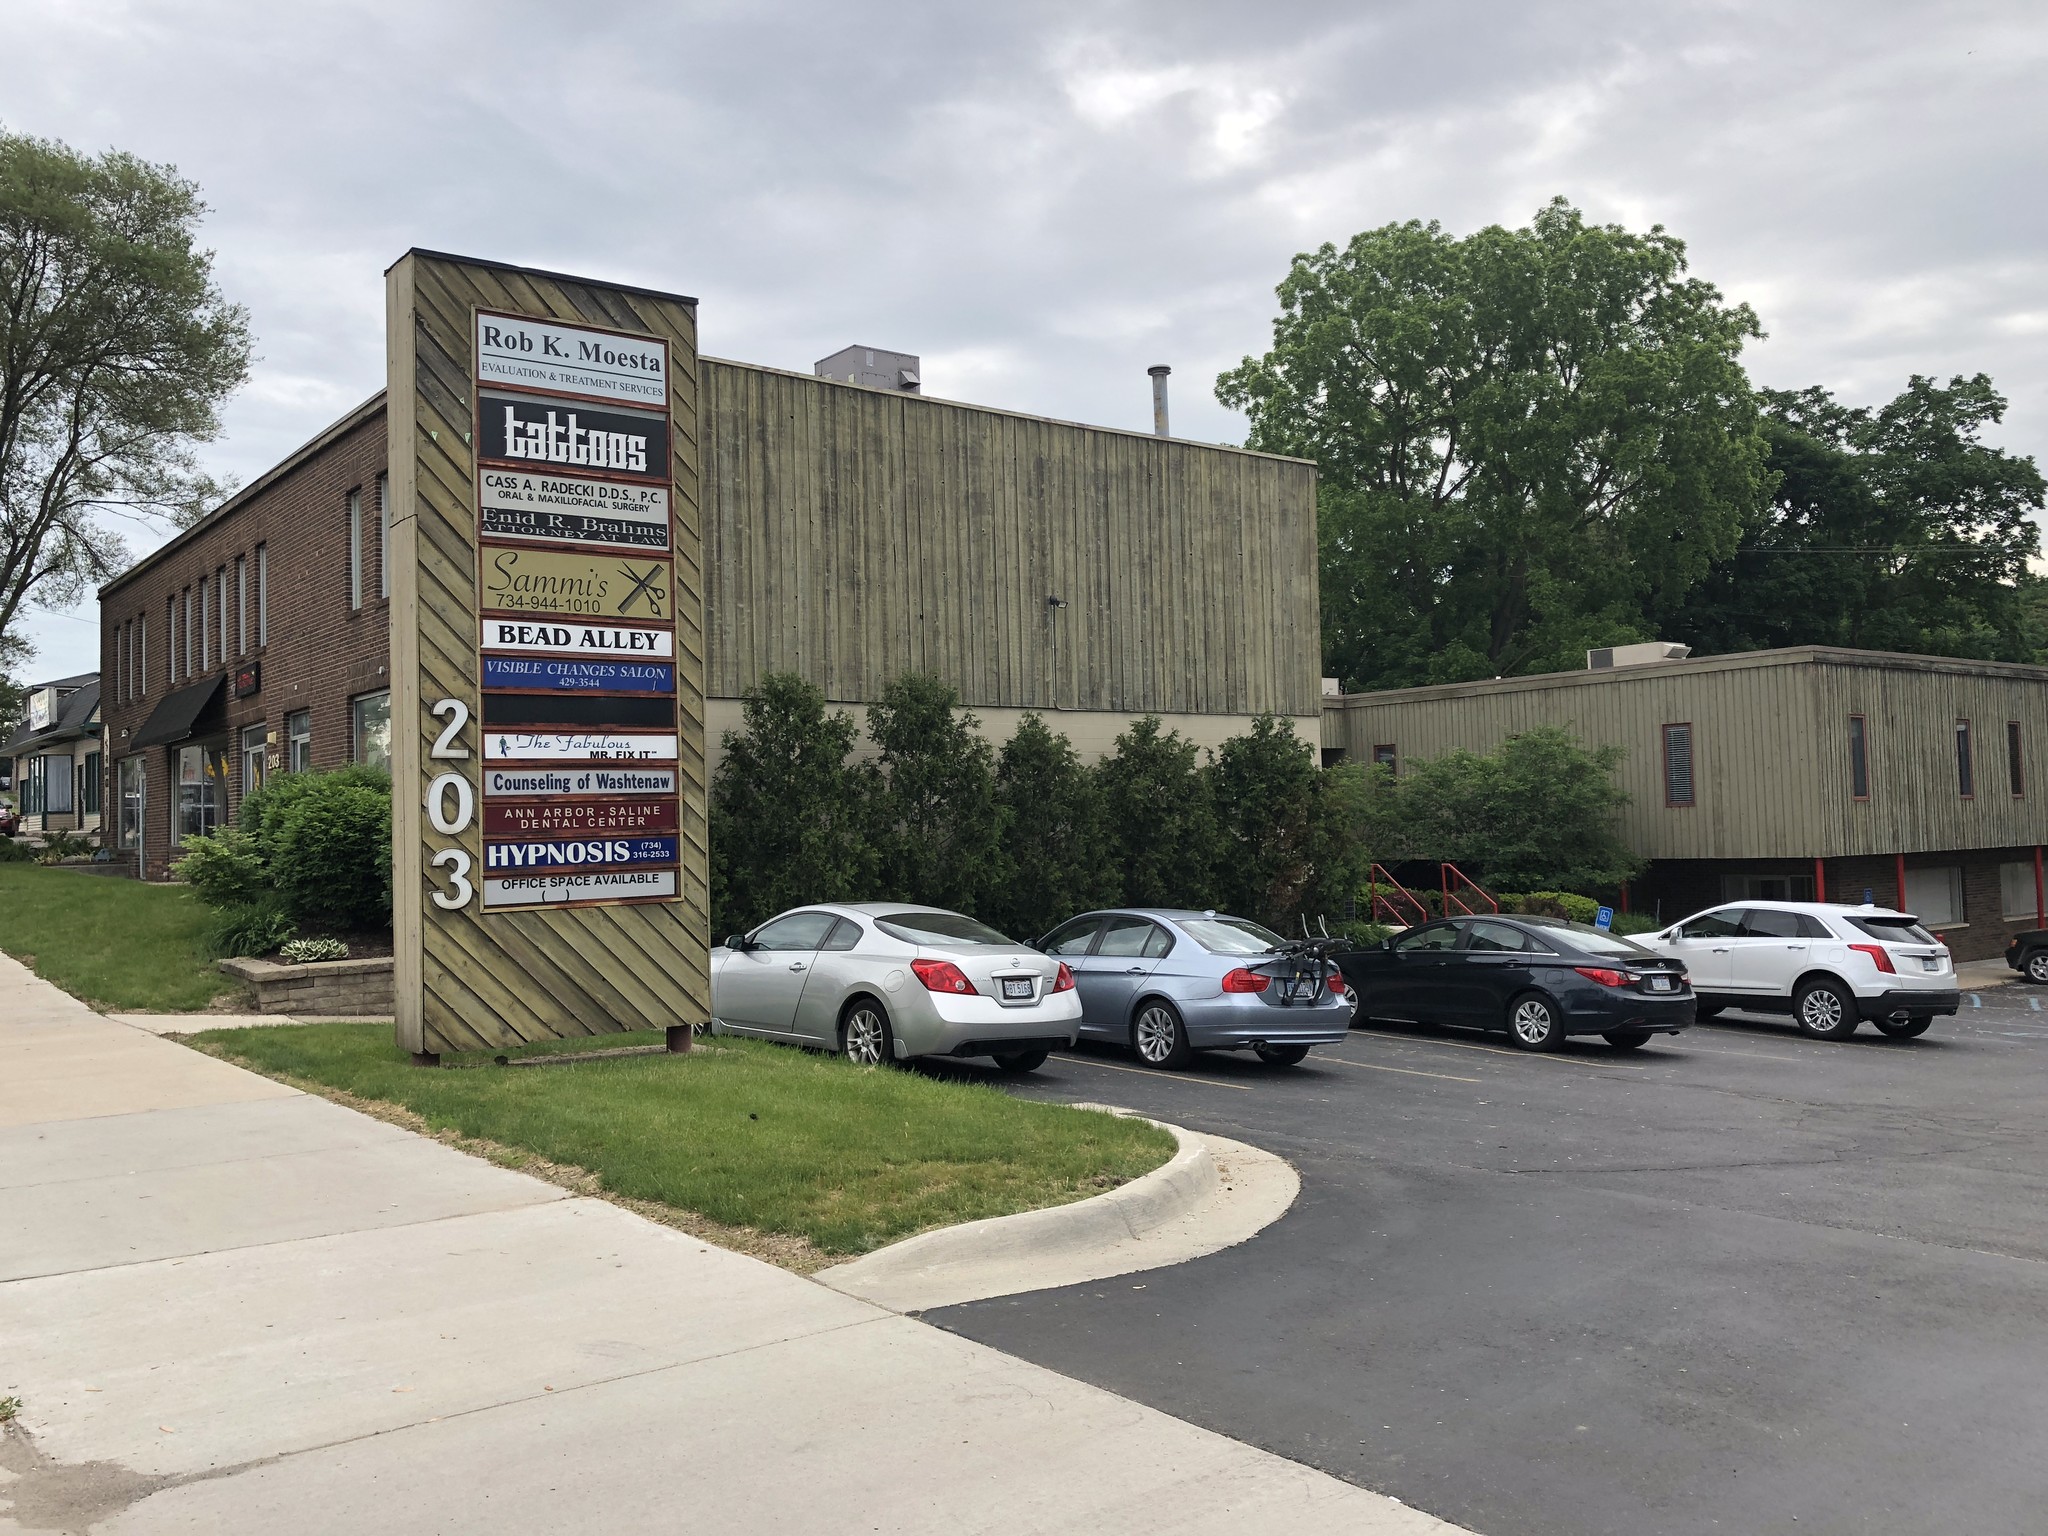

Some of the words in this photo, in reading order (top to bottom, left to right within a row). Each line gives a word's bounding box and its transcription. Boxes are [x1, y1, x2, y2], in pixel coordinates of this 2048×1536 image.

[482, 325, 534, 352] Rob
[542, 335, 570, 358] K.
[578, 340, 661, 372] Moesta
[481, 362, 547, 380] EVALUATION
[549, 371, 557, 381] &
[558, 373, 618, 390] TREATMENT
[619, 381, 664, 397] SERVICES
[485, 475, 518, 489] CASS
[523, 479, 536, 491] A.
[541, 481, 594, 497] RADECKI
[640, 491, 662, 504] P.C.
[498, 490, 524, 501] ORAL
[527, 493, 534, 502] &
[538, 493, 608, 509] MAXILLOFACIAL
[612, 501, 650, 513] SURGERY
[481, 508, 536, 526] Enid
[548, 514, 571, 529] R.
[581, 517, 667, 538] Brahms
[481, 523, 588, 539] ATTORNEY
[597, 533, 620, 541] AT
[629, 536, 666, 546] LAW
[487, 551, 609, 598] Sammi's
[496, 593, 601, 614] 734-944-1010
[498, 625, 572, 647] BEAD
[579, 629, 660, 651] ALLEY
[486, 660, 542, 674] VISIBLE
[547, 663, 616, 677] CHANGES
[620, 666, 667, 680] SALON
[559, 677, 600, 688] 429-3544
[516, 734, 551, 749] The
[556, 734, 631, 752] Fabulous
[268, 753, 280, 770] 203
[589, 751, 612, 759] MR.
[616, 751, 635, 759] FIX
[493, 773, 571, 793] Counseling
[577, 773, 590, 789] of
[596, 773, 670, 789] Washtenaw
[427, 699, 474, 910] 203
[504, 808, 535, 819] ANN
[543, 807, 595, 818] ARBOR
[609, 806, 661, 817] SALINE
[521, 818, 579, 829] DENTAL
[588, 817, 646, 827] CENTER
[488, 840, 630, 867] HYPNOSIS
[641, 841, 662, 850] (734)
[632, 850, 670, 859] 316-2533
[501, 878, 547, 890] OFFICE
[549, 876, 591, 888] SPACE
[593, 873, 660, 885] AVAILABLE
